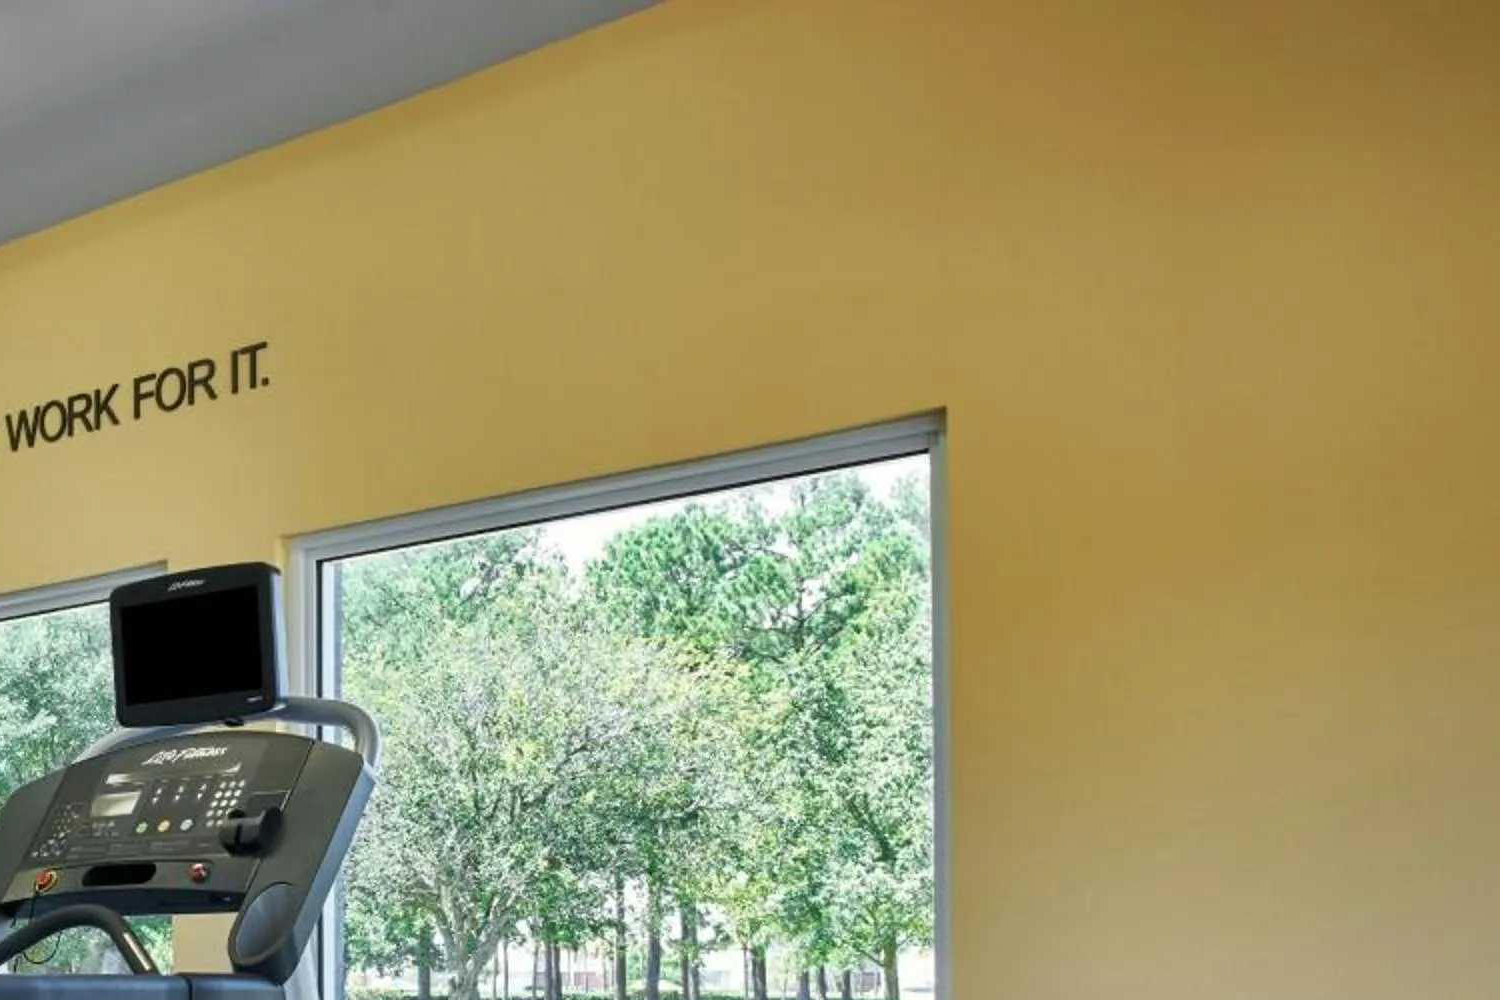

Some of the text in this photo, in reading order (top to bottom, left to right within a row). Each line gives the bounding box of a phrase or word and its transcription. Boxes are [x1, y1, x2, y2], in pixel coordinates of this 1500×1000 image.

[6, 383, 120, 452] WORK
[132, 359, 218, 418] FOR
[230, 341, 271, 395] IT.
